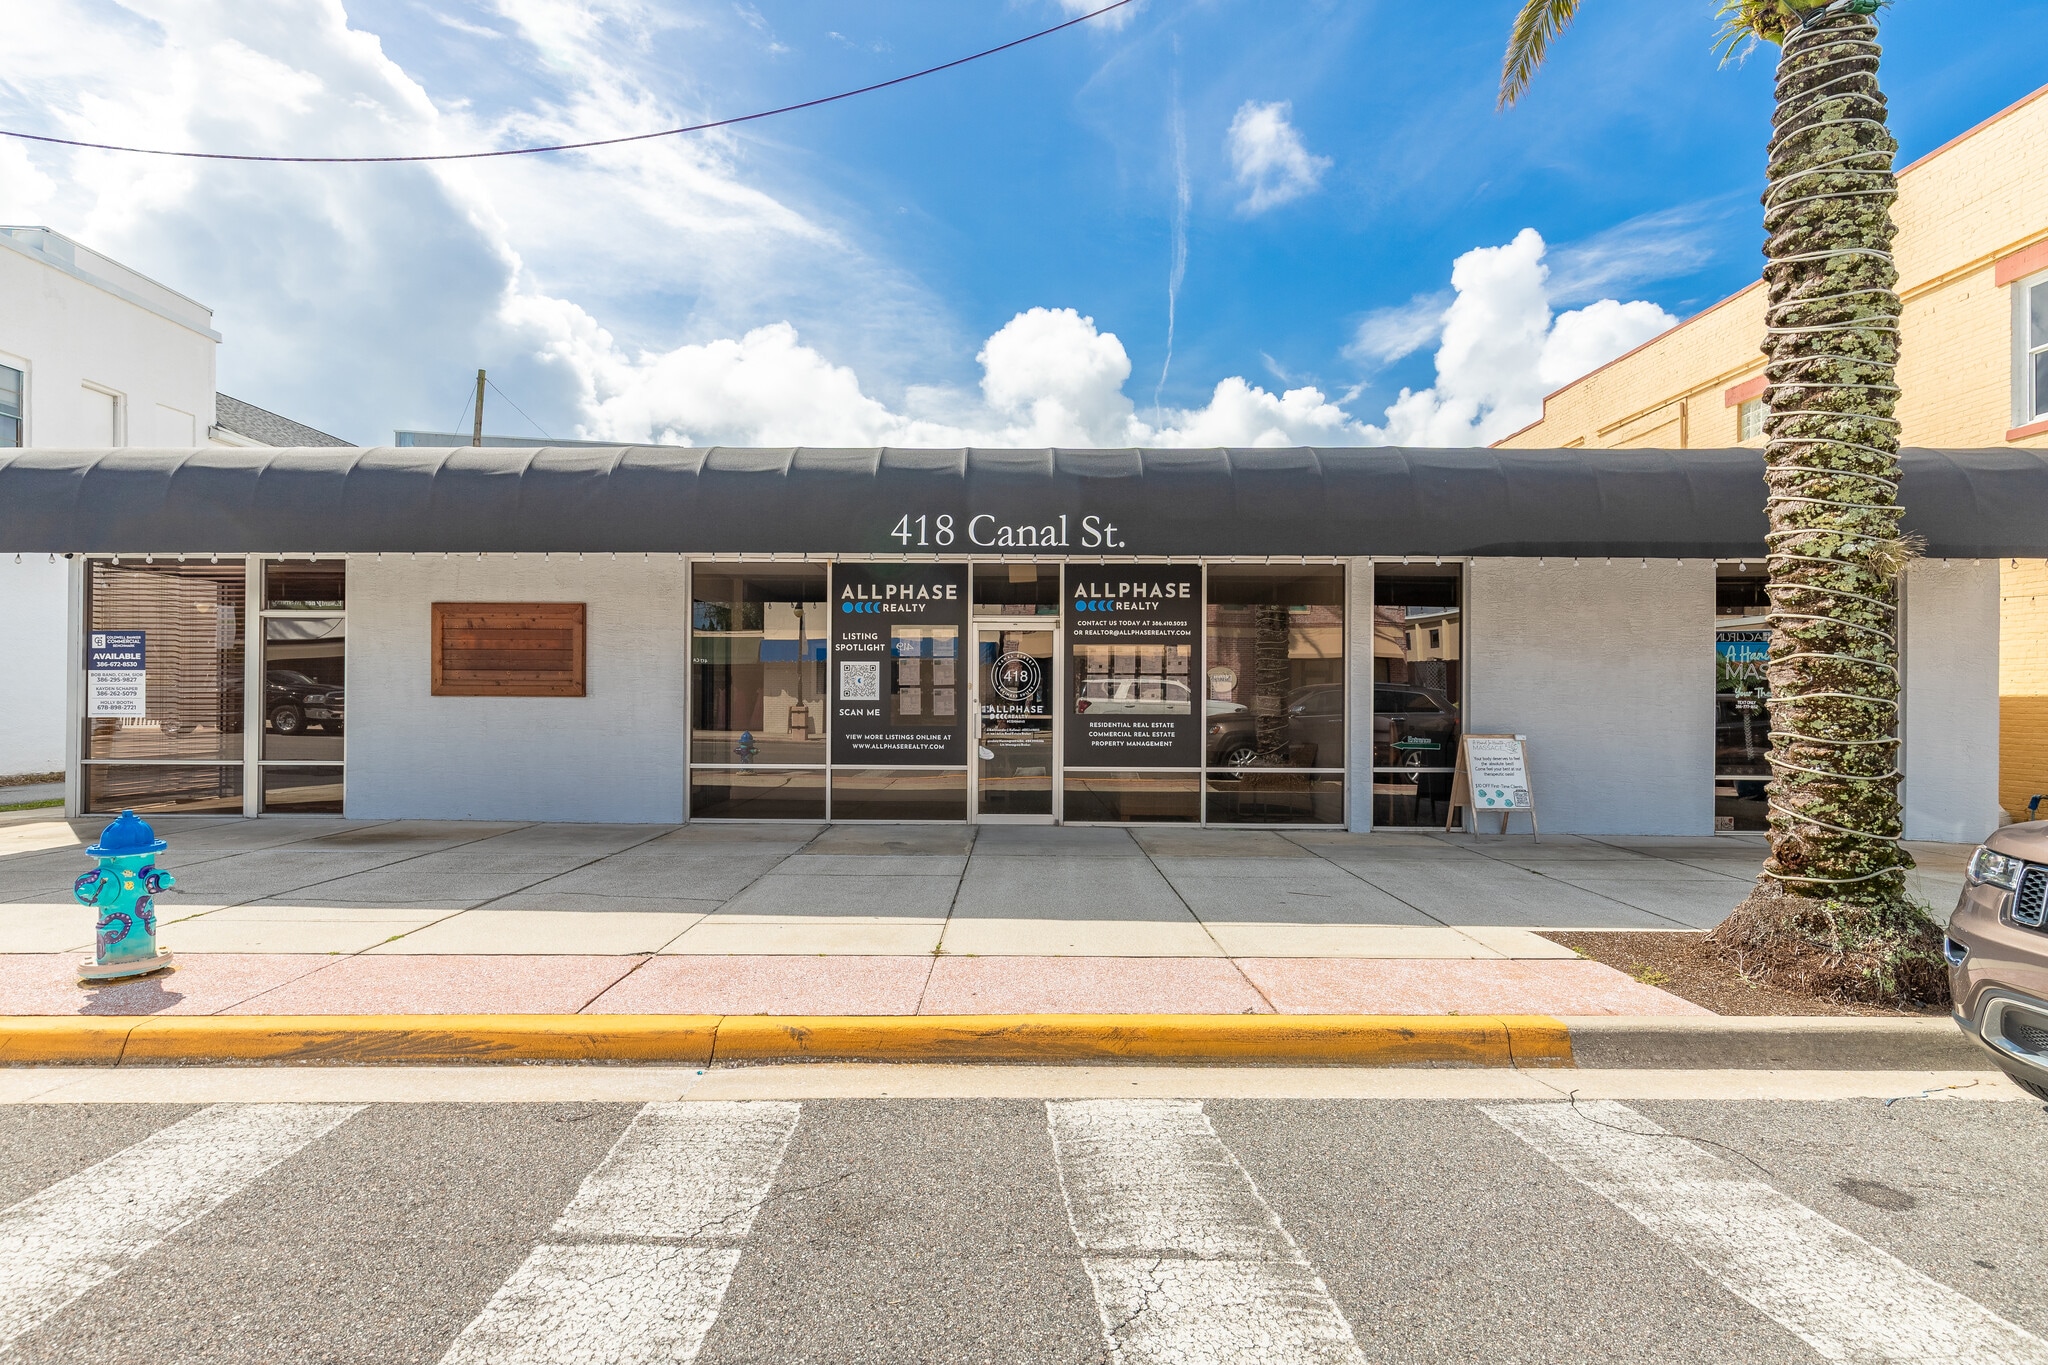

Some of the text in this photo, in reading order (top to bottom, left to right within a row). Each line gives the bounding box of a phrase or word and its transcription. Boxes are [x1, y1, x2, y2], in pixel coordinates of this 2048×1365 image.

[891, 514, 1126, 548] 418 Canal St.
[841, 584, 957, 600] ALLPHASE
[1074, 583, 1190, 598] ALLPHASE
[883, 604, 926, 612] REALTY
[1116, 602, 1159, 610] REALTY
[1726, 645, 1736, 663] A
[1004, 671, 1028, 682] 418
[1735, 687, 1753, 698] Your
